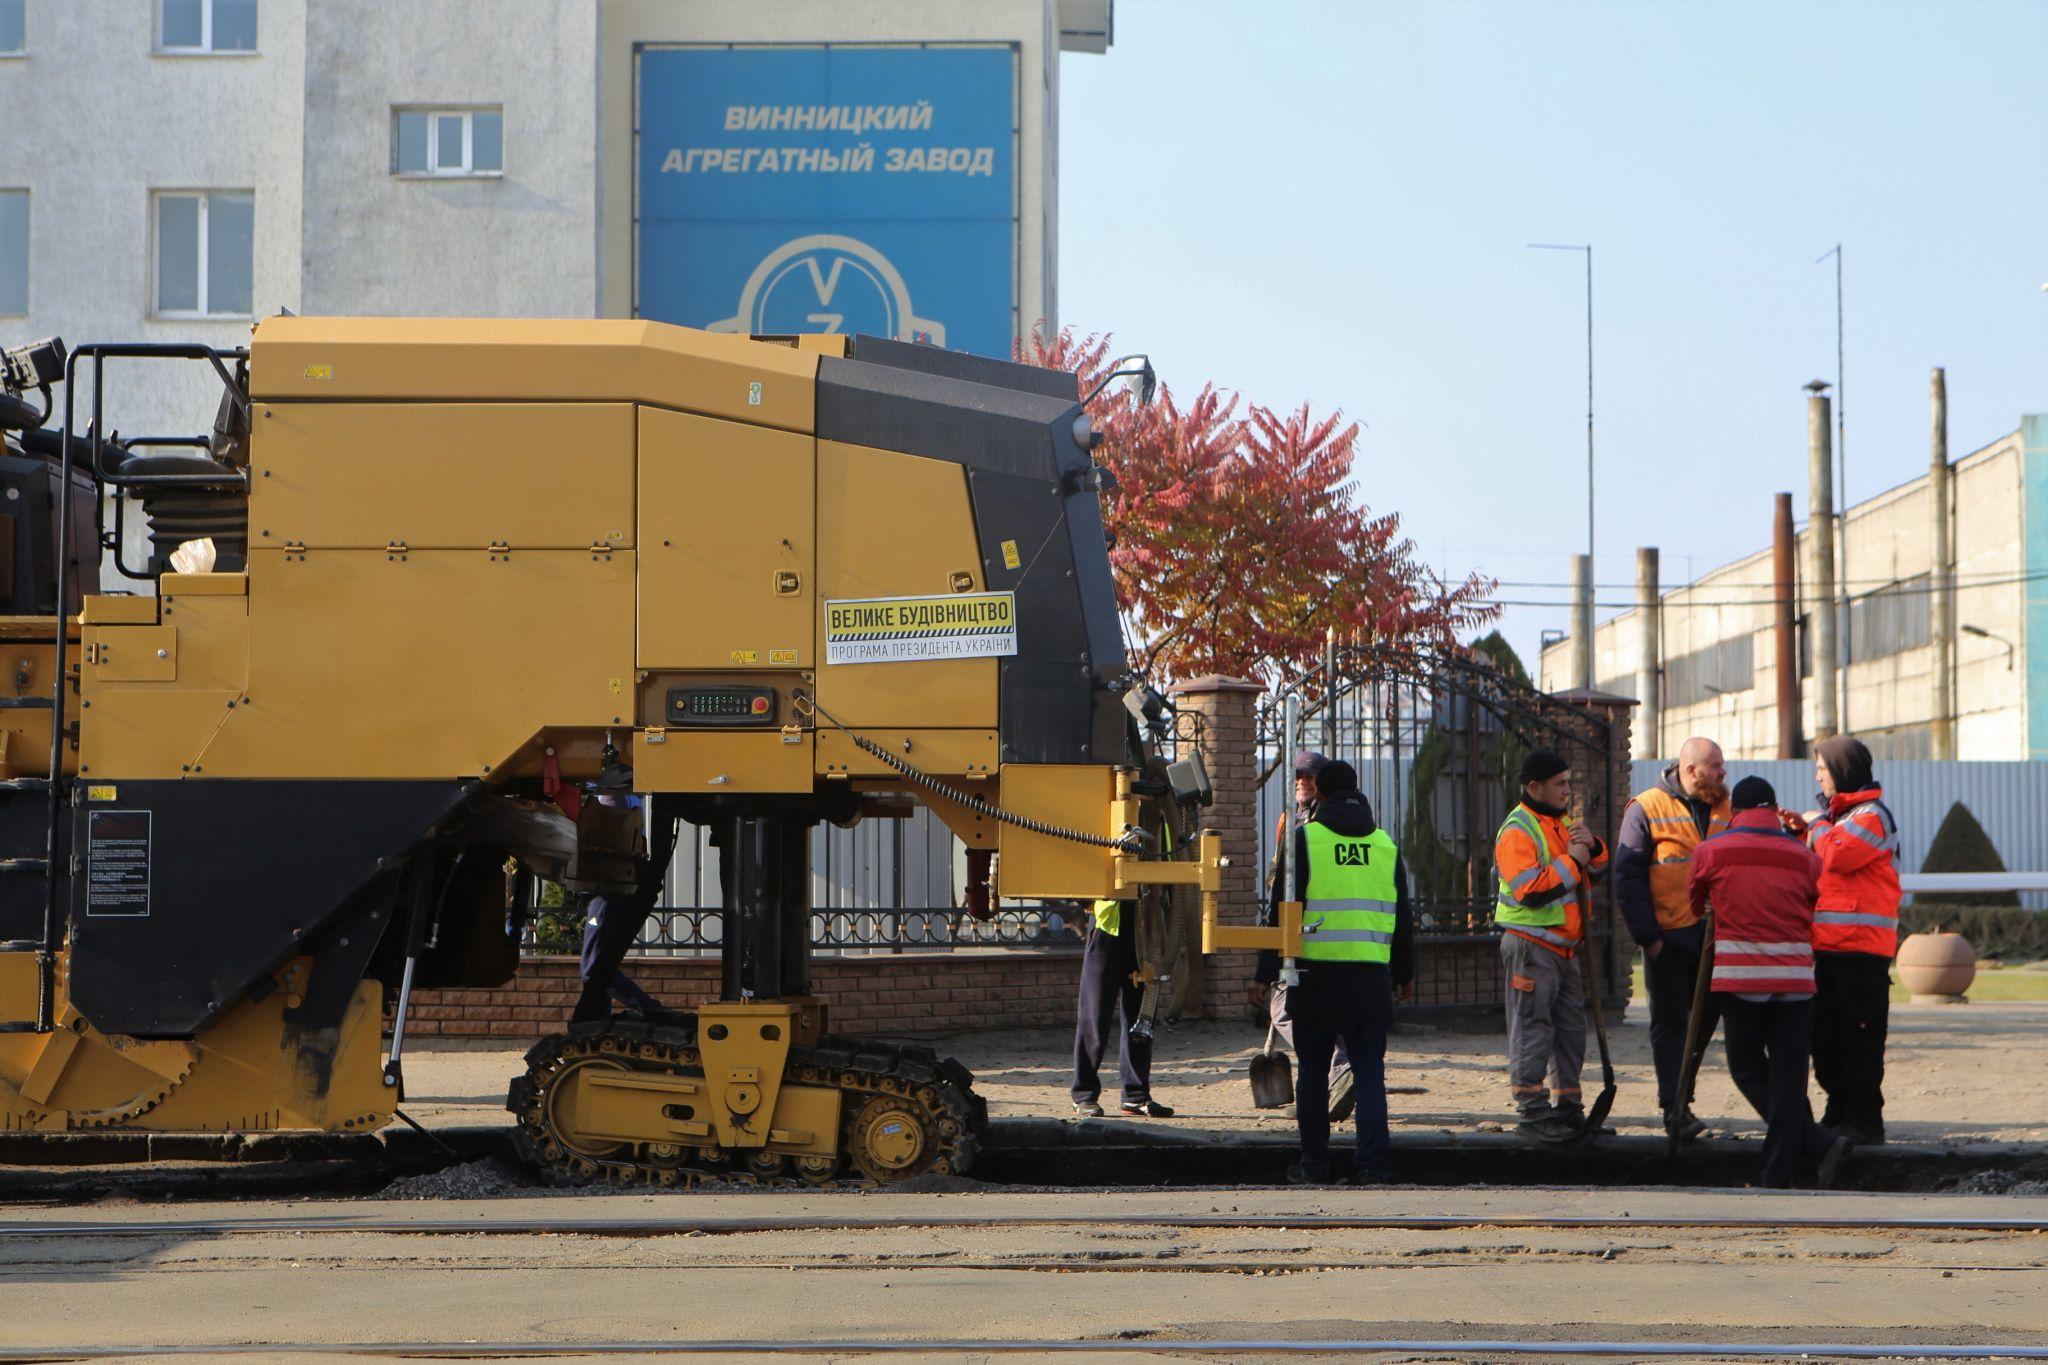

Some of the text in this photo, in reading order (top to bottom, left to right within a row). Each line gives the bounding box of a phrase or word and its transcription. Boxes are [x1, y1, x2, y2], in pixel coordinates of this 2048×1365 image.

[724, 100, 934, 135] ВИННИЦКИЙ
[661, 142, 994, 177] АГРЕГАТНЫЙ ЗАВОД
[832, 602, 1008, 628] ВЕЛИКЕ БУДІВНИЦТВО
[832, 636, 1011, 660] ПРОГРАМА ПРЕЗИДЕНТА УКРАЇНИ
[1334, 843, 1371, 866] CAT
